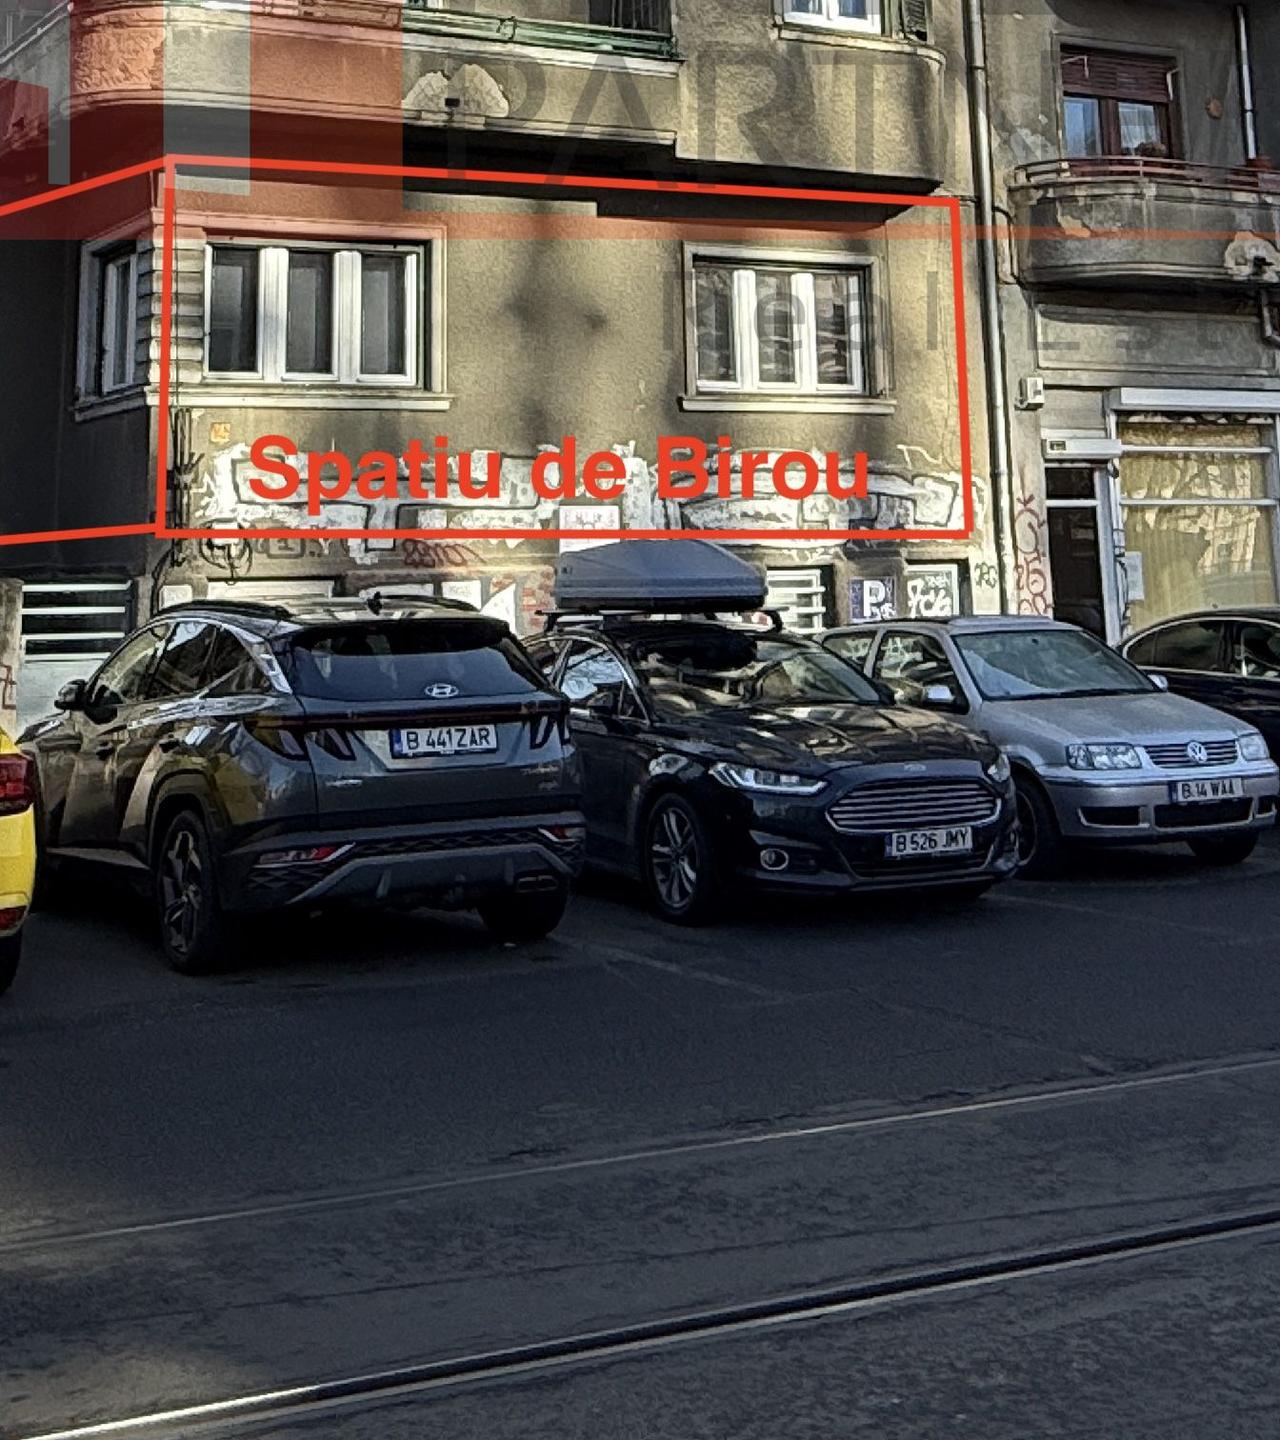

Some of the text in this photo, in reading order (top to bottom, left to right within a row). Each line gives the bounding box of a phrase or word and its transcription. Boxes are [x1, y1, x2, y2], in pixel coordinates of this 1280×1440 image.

[407, 732, 418, 750] B
[1182, 783, 1191, 799] B
[896, 835, 907, 853] B
